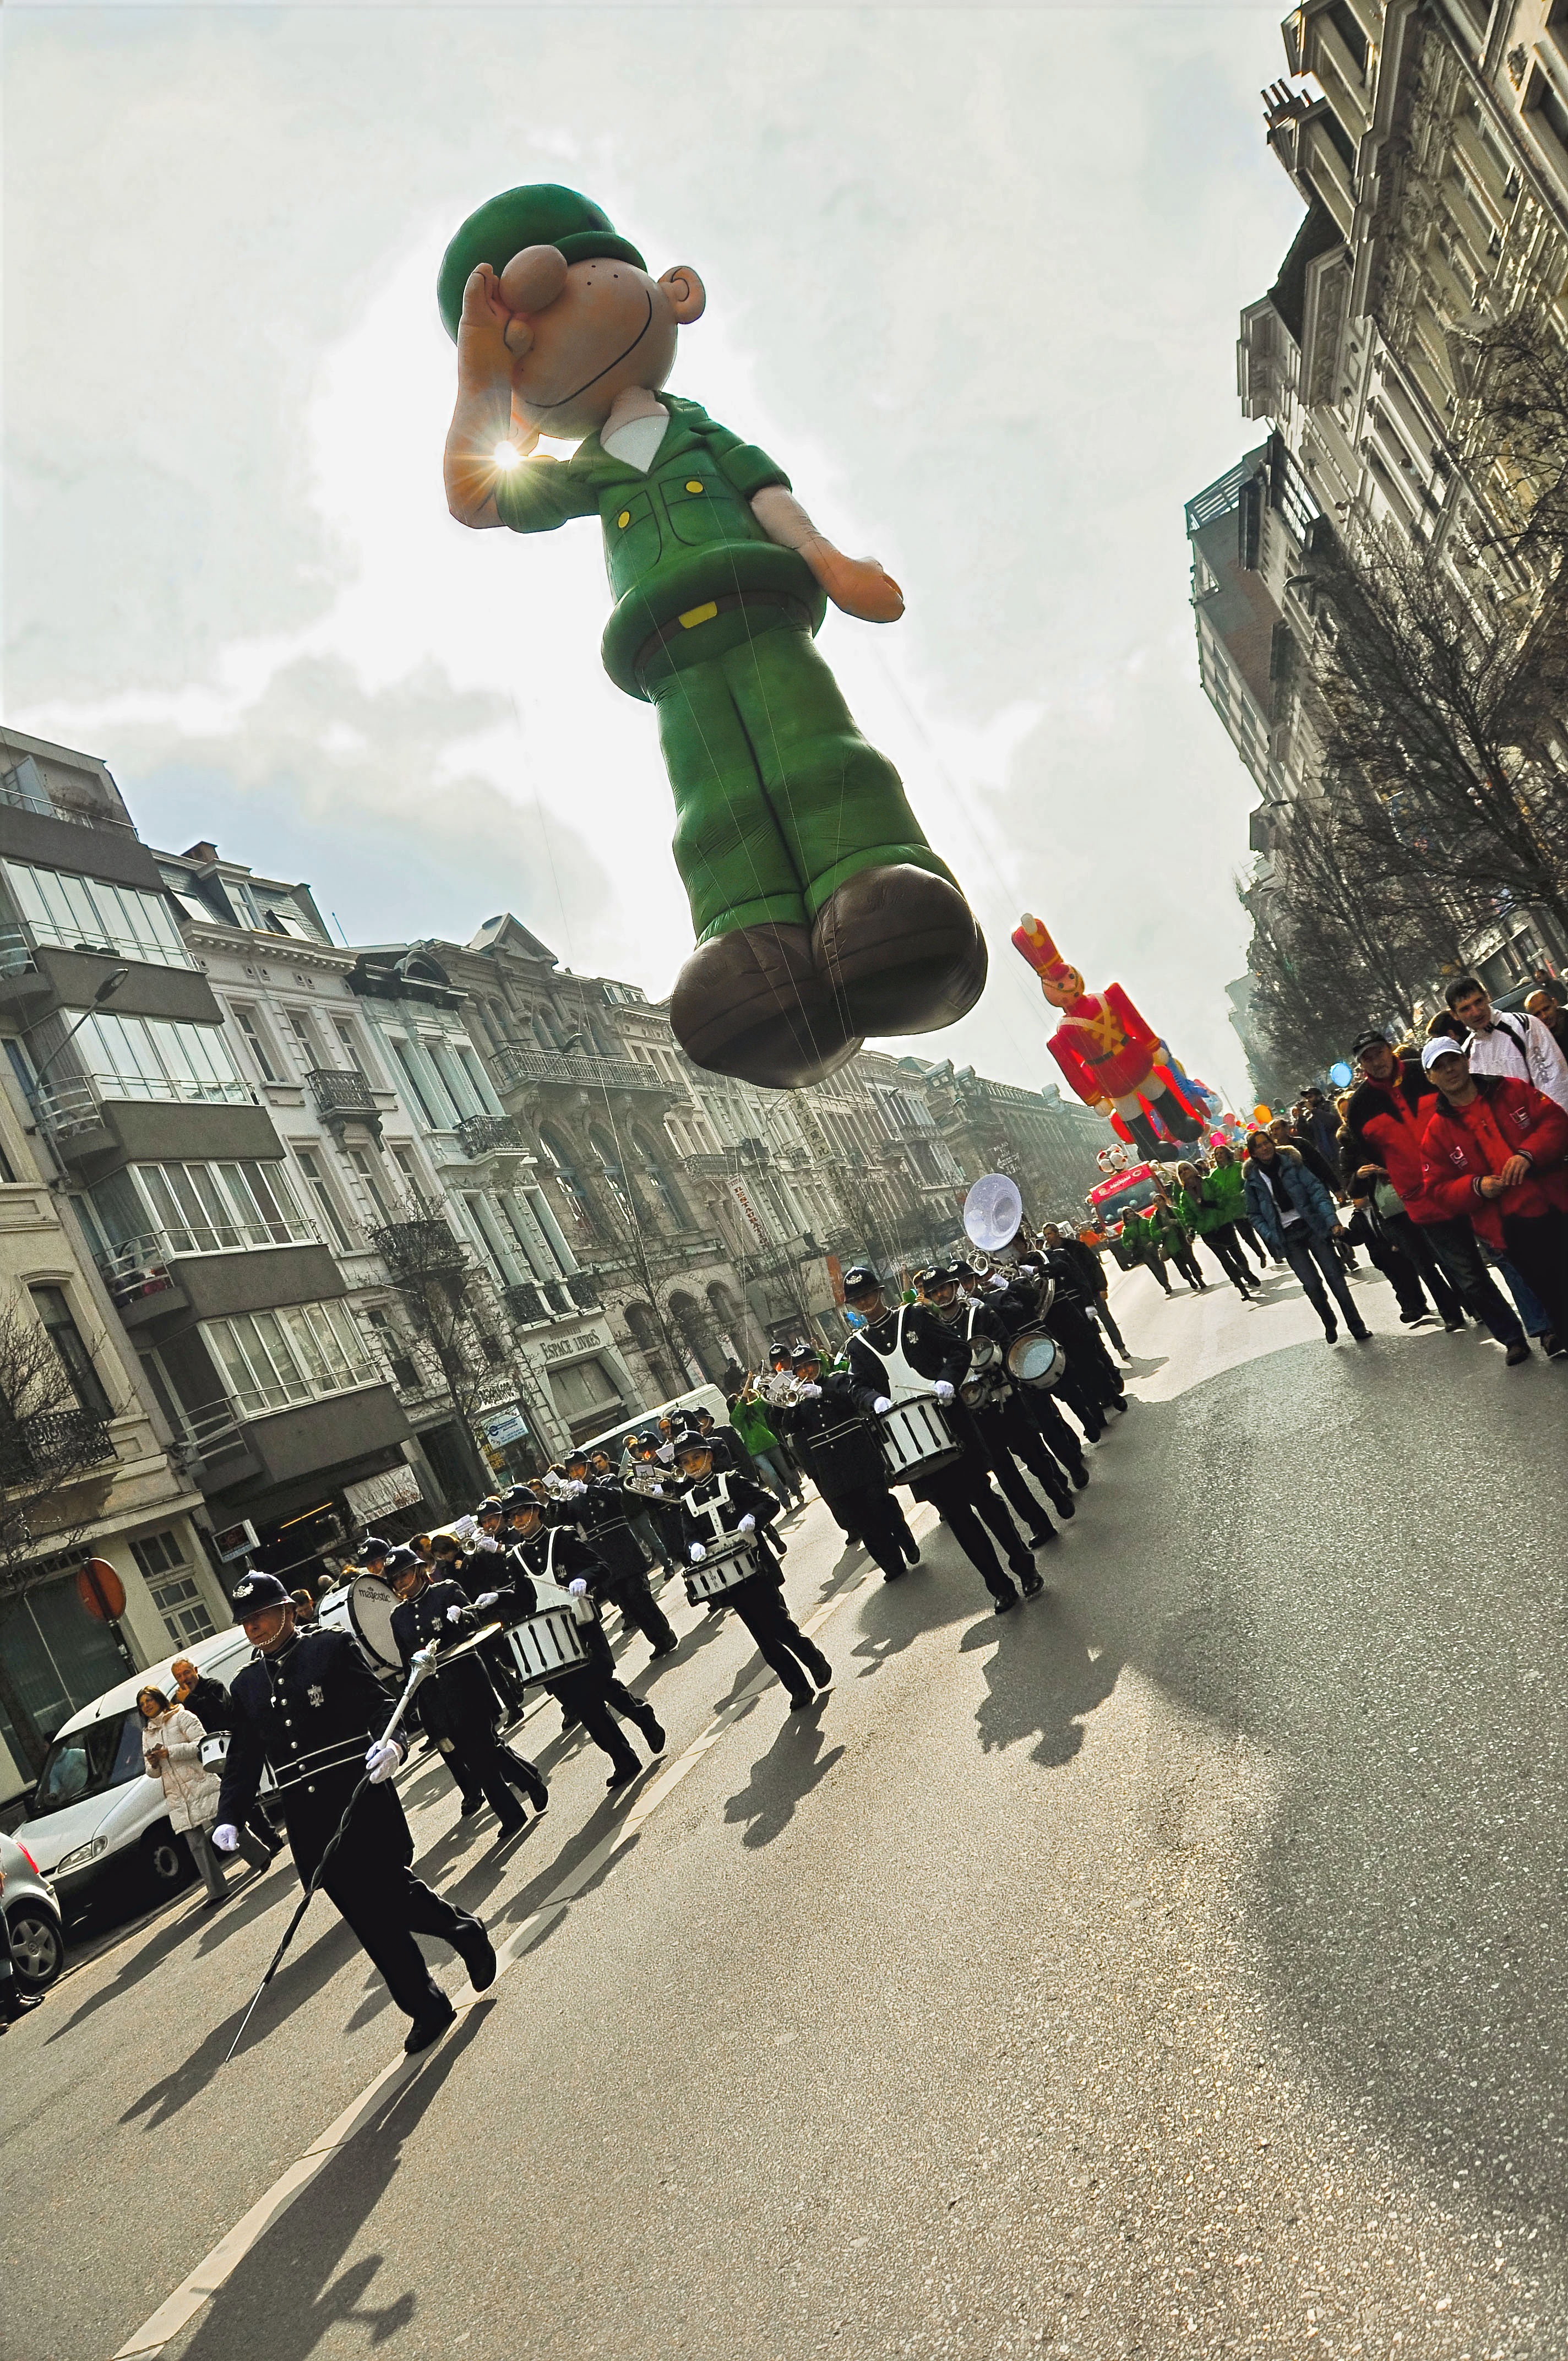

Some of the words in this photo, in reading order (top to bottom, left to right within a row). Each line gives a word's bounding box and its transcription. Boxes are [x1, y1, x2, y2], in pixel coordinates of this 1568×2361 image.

[540, 1340, 574, 1360] ESPACE
[573, 1329, 601, 1351] LIVRES
[358, 1589, 391, 1602] majestic
